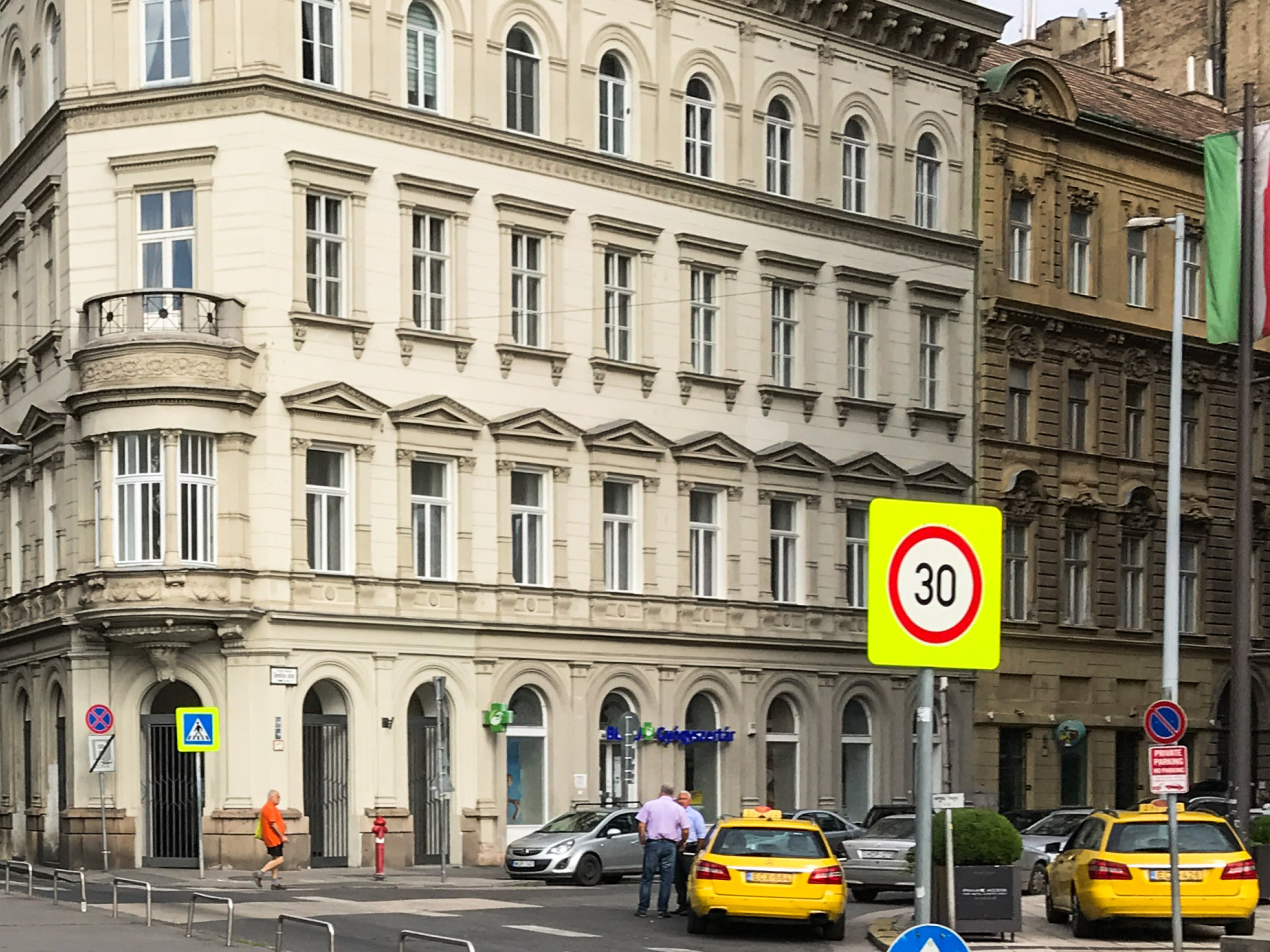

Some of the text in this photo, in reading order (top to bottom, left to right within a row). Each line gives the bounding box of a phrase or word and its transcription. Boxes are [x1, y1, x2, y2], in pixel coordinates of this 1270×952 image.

[914, 562, 957, 608] 30
[1154, 749, 1183, 757] PRIVATE
[1153, 758, 1184, 767] PARKING
